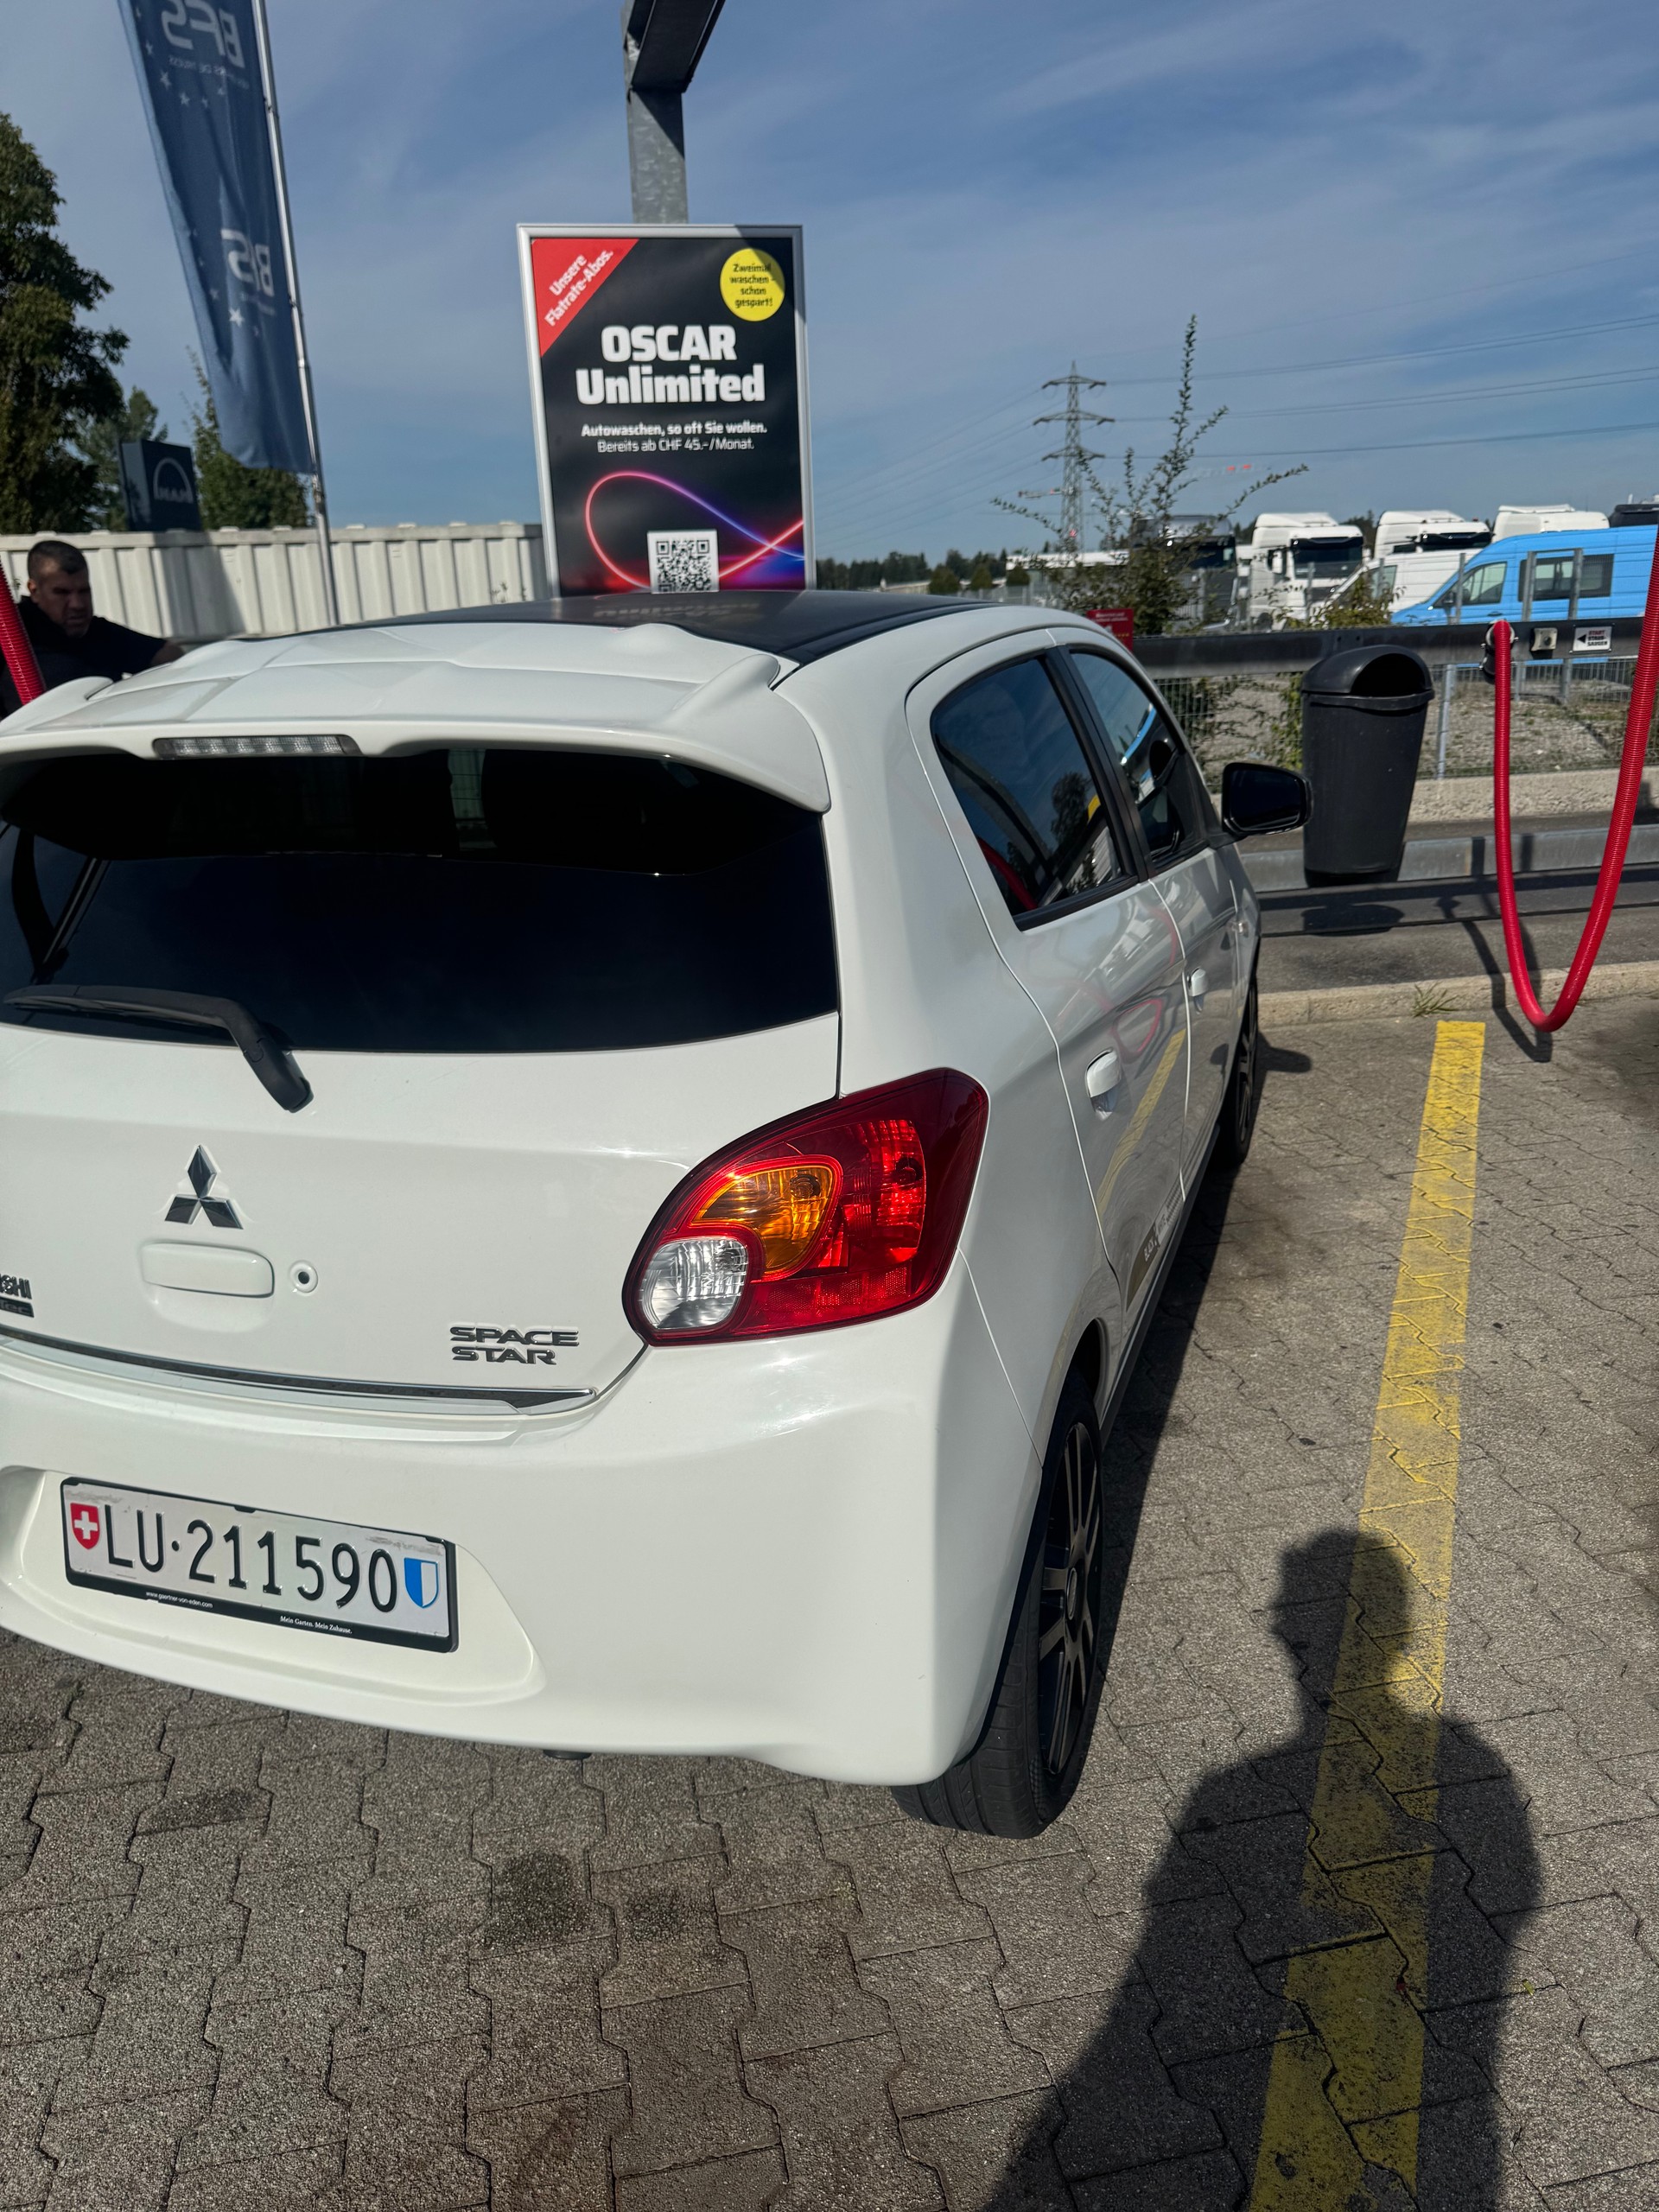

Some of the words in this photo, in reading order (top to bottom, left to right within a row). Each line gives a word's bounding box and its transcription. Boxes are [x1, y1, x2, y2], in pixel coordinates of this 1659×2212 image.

[549, 255, 588, 296] Unsere
[732, 263, 771, 273] Zweimal
[543, 250, 613, 327] Flatrate-Abos.
[729, 274, 769, 284] waschen
[740, 286, 766, 296] schon
[734, 297, 772, 308] gespart!
[601, 324, 737, 362] OSCAR
[575, 363, 766, 404] Unlimited
[581, 422, 665, 437] Autowaschen,
[667, 423, 681, 435] so
[683, 422, 702, 434] oft
[704, 420, 723, 434] Sie
[726, 419, 767, 434] wollen.
[597, 439, 639, 453] Bereits
[641, 439, 656, 452] ab
[658, 439, 682, 452] CHF
[449, 1326, 580, 1347] SPACE
[451, 1345, 557, 1365] STAR
[145, 1590, 214, 1609] www.gaertner-von-eden.com
[280, 1615, 294, 1624] Mein
[295, 1618, 314, 1628] Garten.
[315, 1621, 329, 1631] Mein
[329, 1624, 353, 1635] Zuhause.
